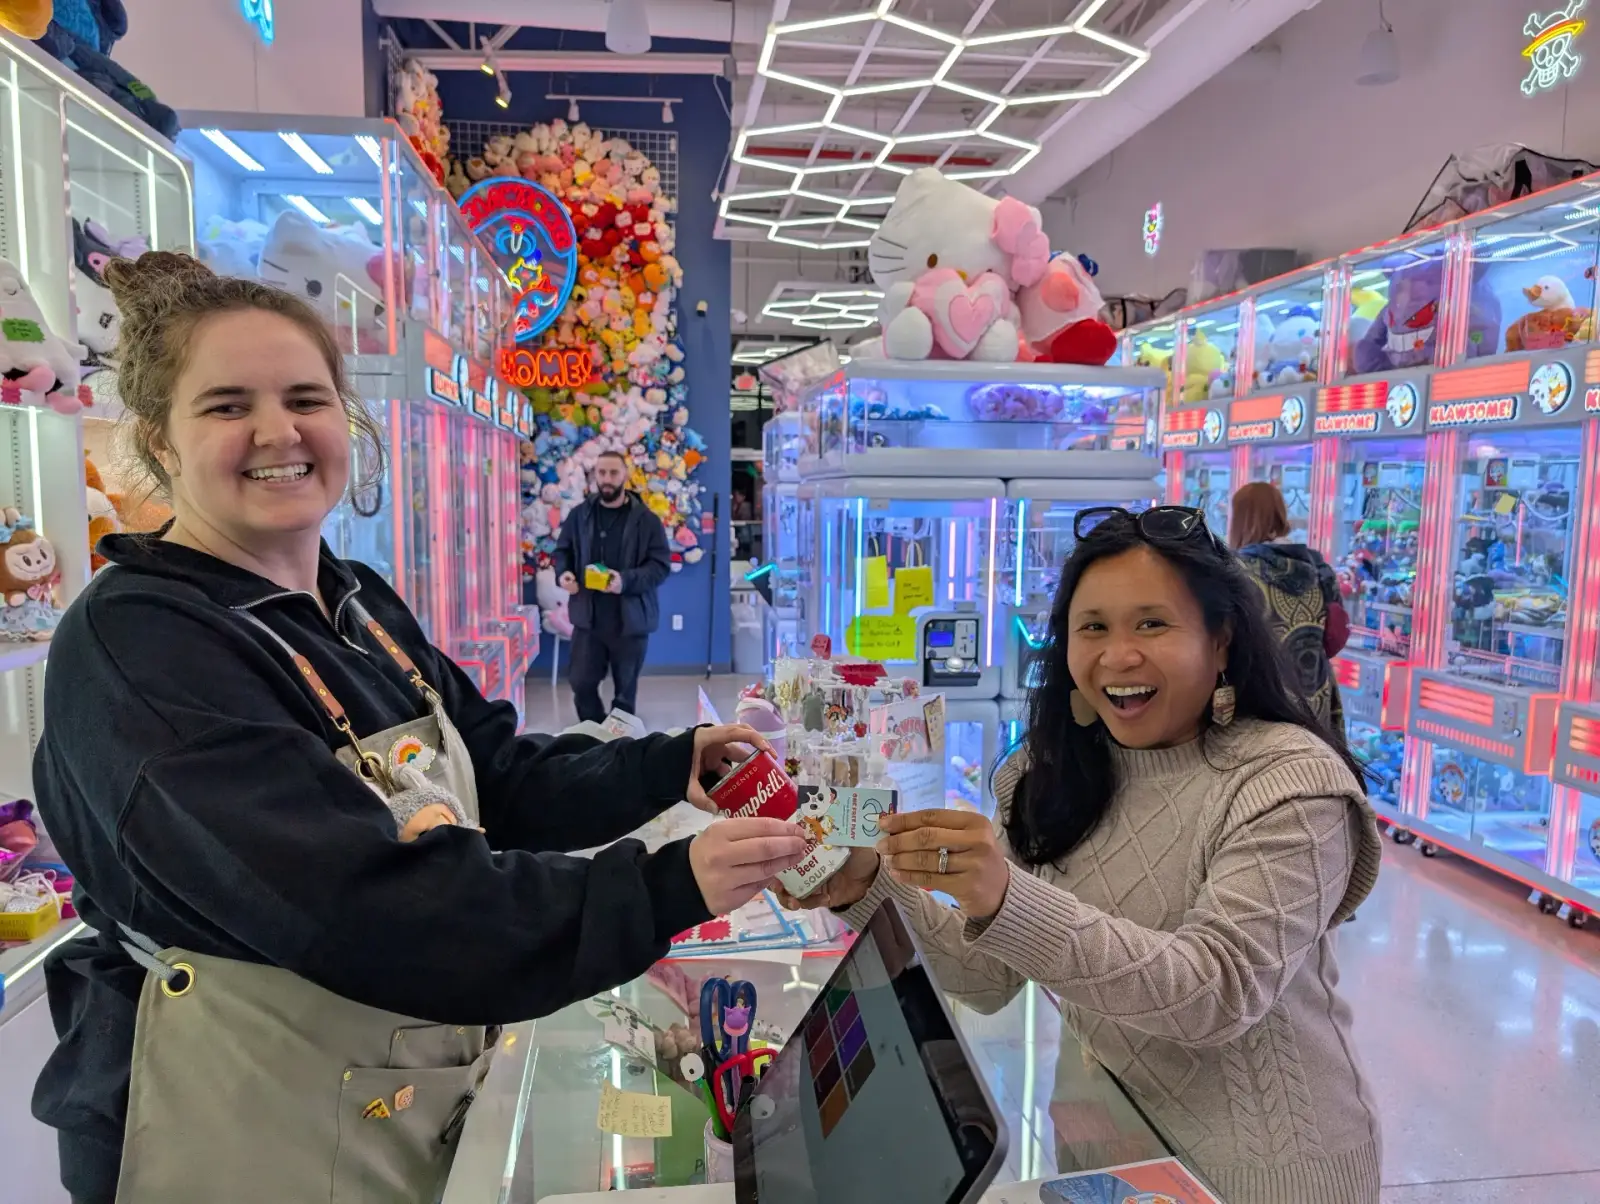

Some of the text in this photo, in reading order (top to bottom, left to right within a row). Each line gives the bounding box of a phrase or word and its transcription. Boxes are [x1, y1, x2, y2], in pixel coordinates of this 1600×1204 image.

[1314, 413, 1376, 432] KLAWSOME!
[1430, 399, 1513, 425] KLAWSOME!
[720, 766, 758, 800] CONDENSED
[796, 855, 819, 877] Beef
[803, 865, 827, 888] SOUP
